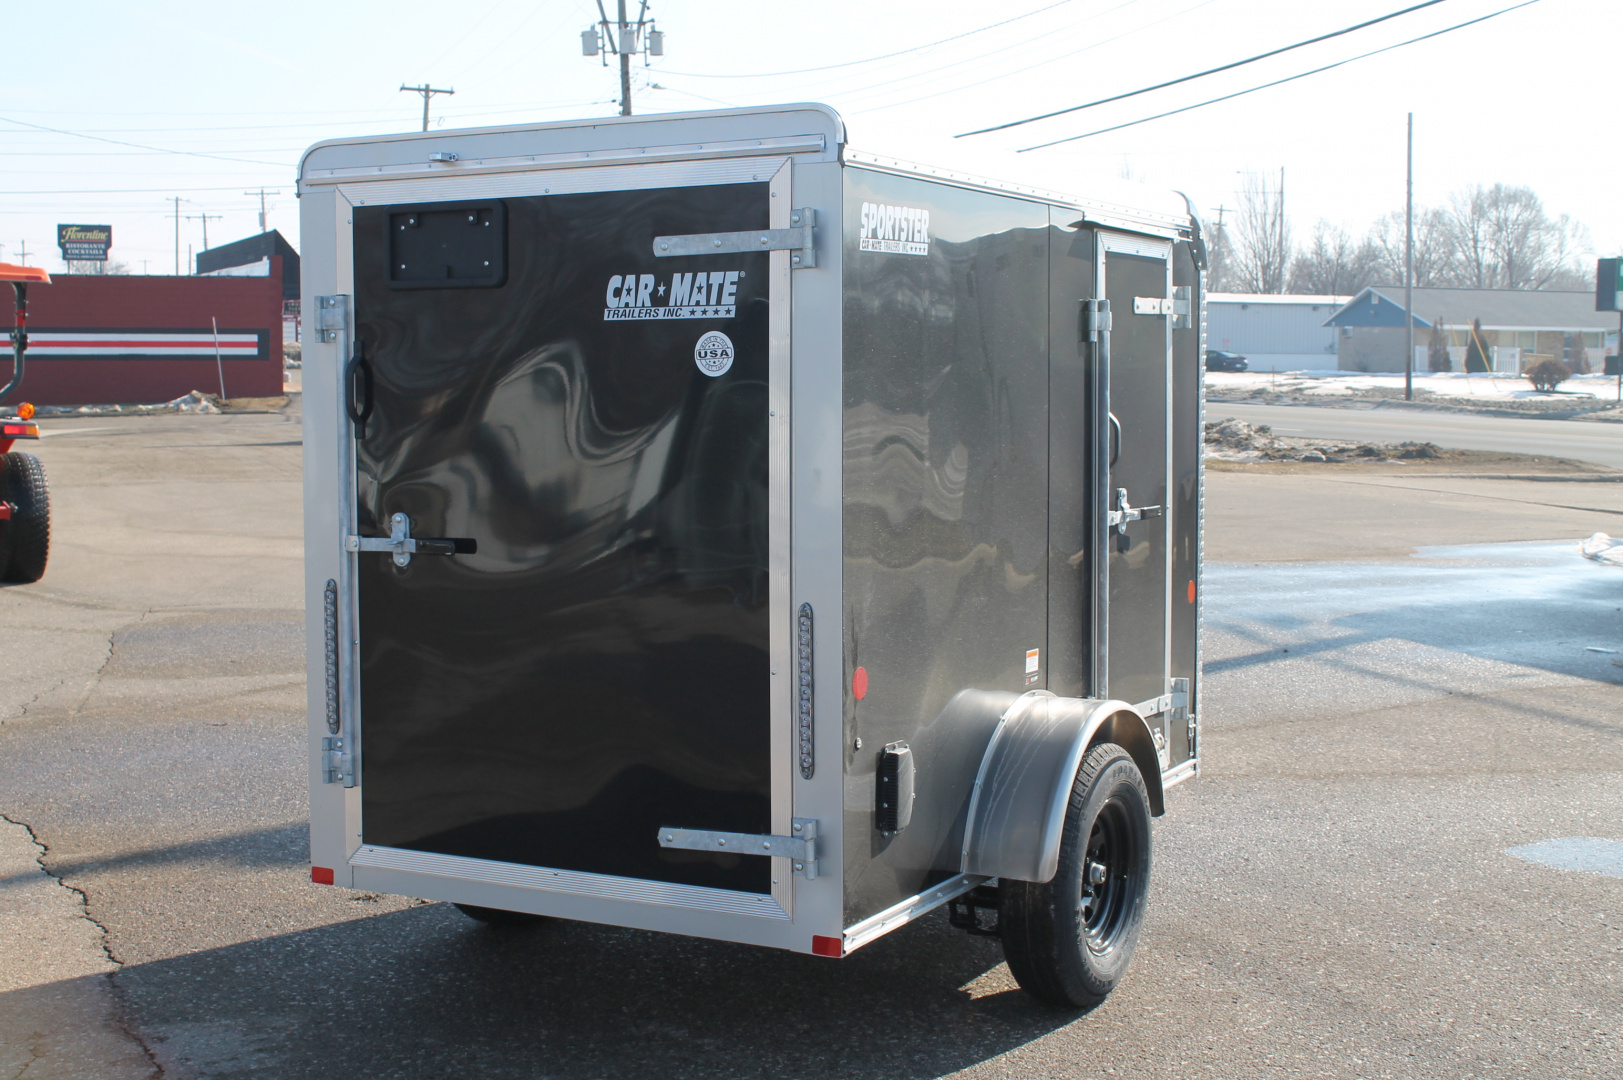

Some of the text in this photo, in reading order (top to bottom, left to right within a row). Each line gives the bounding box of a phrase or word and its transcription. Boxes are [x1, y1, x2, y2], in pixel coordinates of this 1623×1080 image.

[861, 202, 930, 243] SPORTSTER
[61, 226, 108, 242] Florentine
[606, 274, 655, 308] CAR
[606, 307, 686, 319] TRAILERS INC.
[701, 337, 713, 350] MADE
[719, 337, 729, 349] THE
[697, 349, 730, 359] USA
